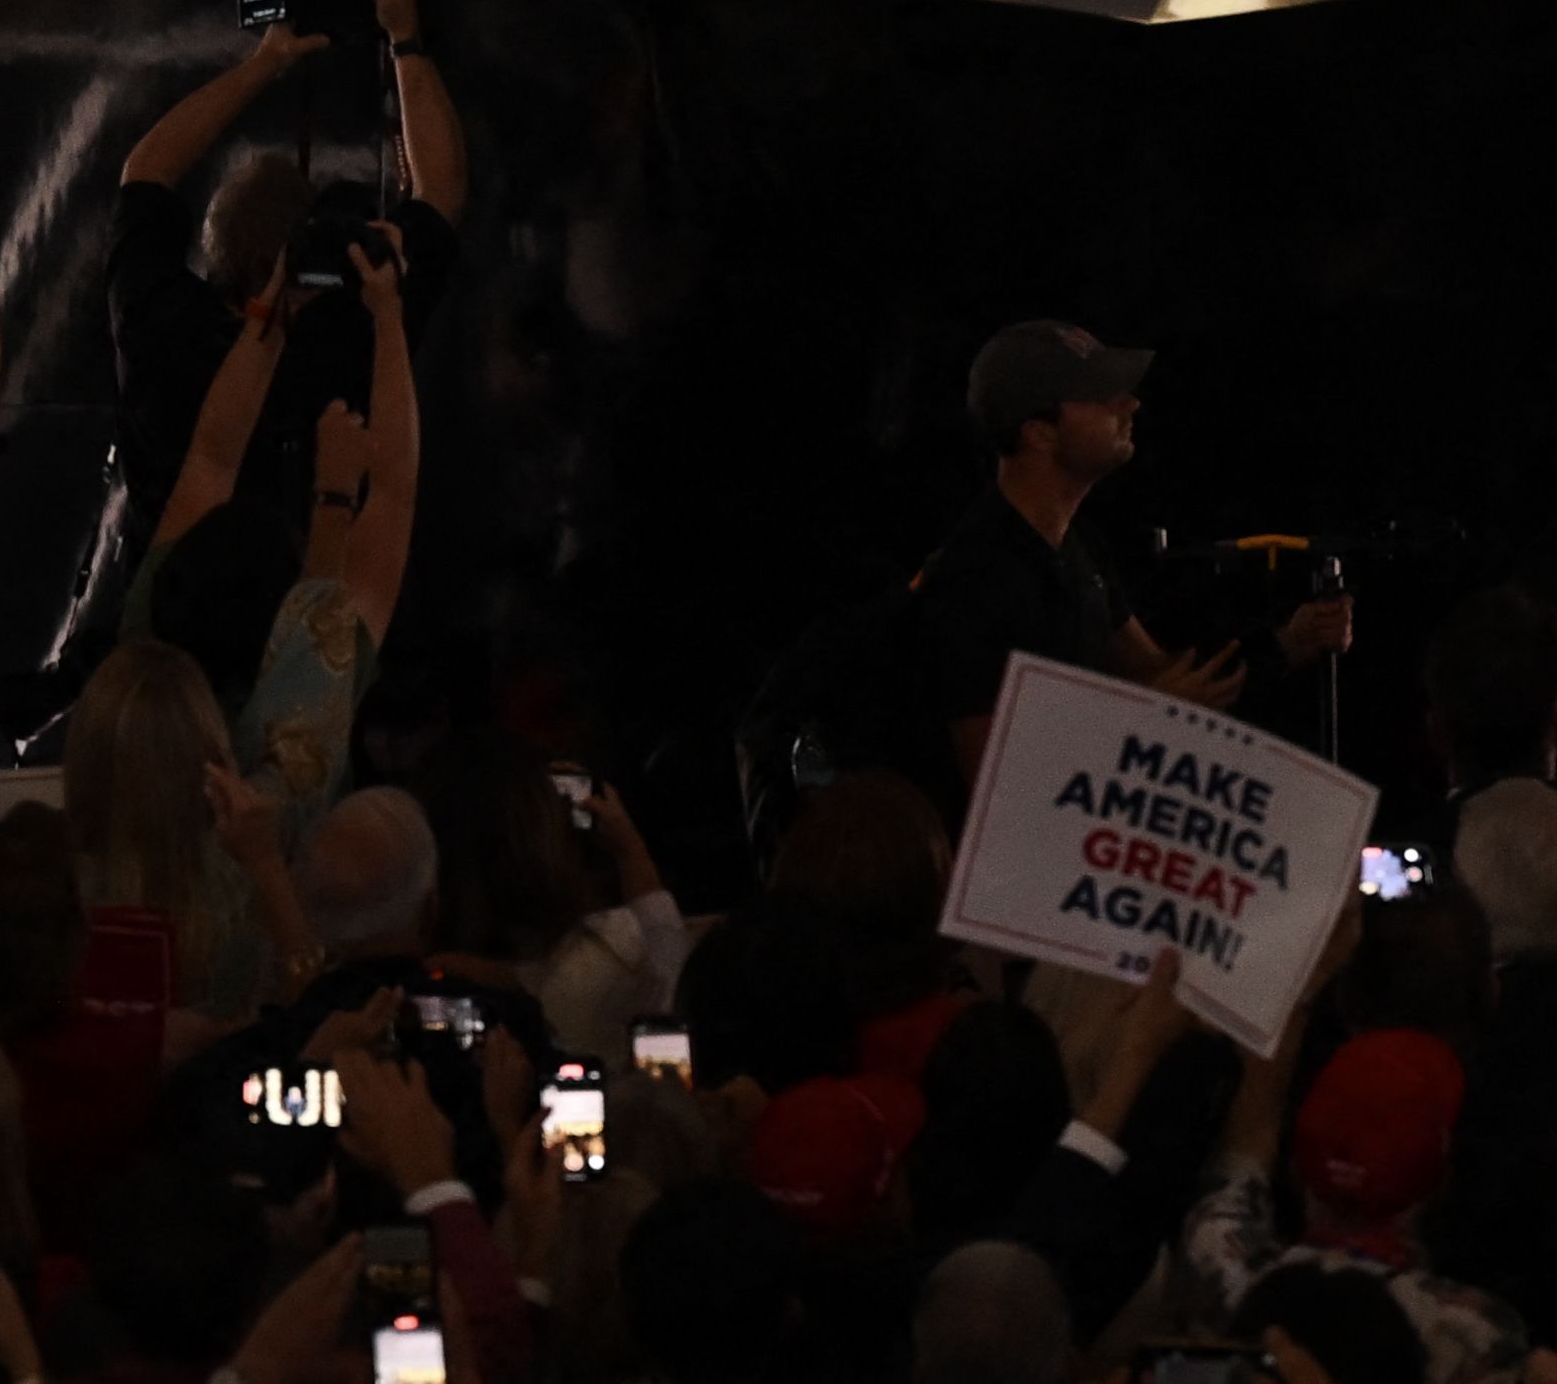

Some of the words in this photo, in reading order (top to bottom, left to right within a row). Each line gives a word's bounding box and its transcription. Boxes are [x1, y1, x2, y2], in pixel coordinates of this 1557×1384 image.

[1117, 735, 1275, 825] MAKE
[1054, 771, 1291, 892] AMERICA
[1081, 829, 1259, 920] GREAT
[1060, 874, 1246, 972] AGAIN!
